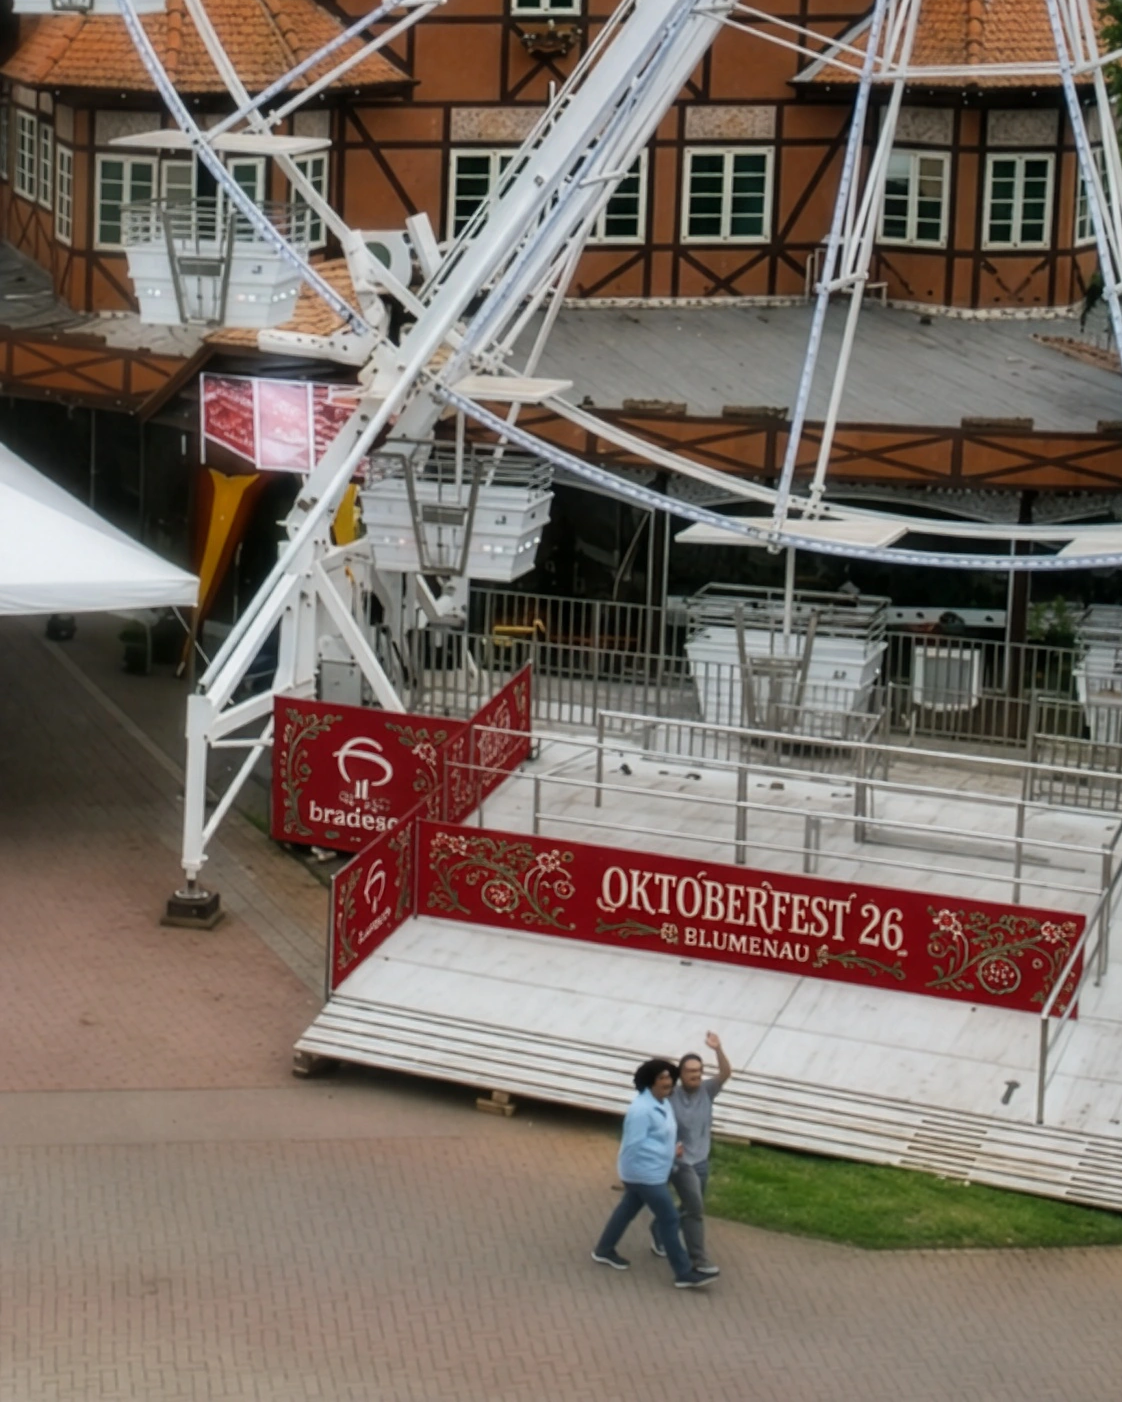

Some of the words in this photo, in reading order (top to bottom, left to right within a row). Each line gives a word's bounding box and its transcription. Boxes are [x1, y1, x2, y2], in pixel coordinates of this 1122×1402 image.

[309, 800, 399, 831] bradesc
[597, 866, 856, 941] OKTOBERFEST
[860, 905, 906, 951] 26
[684, 929, 810, 963] BLUMENAU
